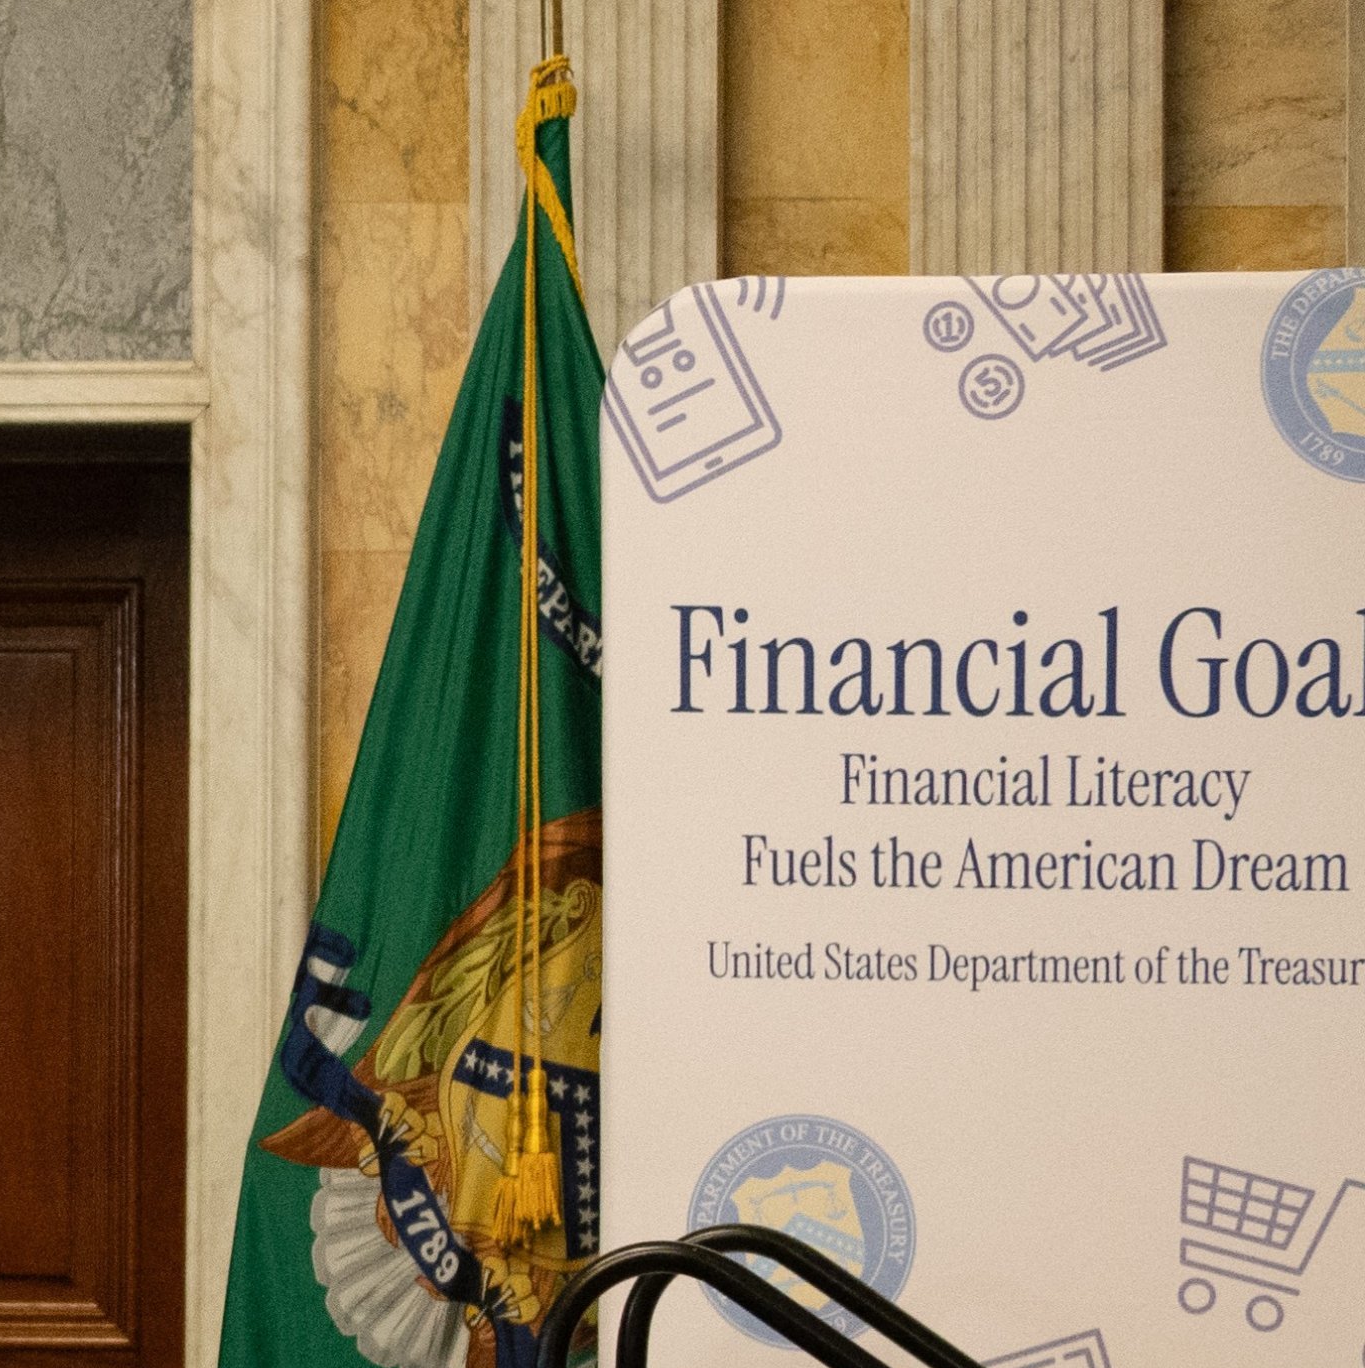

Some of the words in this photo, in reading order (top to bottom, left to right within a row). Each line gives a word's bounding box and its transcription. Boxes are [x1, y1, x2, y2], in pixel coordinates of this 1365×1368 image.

[1300, 431, 1345, 467] 1789
[670, 605, 1129, 719] Financial
[841, 753, 1053, 808] Financial
[1067, 755, 1253, 822] Literacy
[743, 834, 859, 889] Fuels
[871, 837, 943, 890] the
[955, 838, 1180, 892] American
[1193, 839, 1351, 893] Dream
[709, 941, 816, 980] United
[825, 943, 919, 982] States
[929, 944, 1126, 993] Department
[1134, 946, 1171, 986] of
[1177, 947, 1231, 986] the
[1238, 947, 1365, 987] Treasur
[696, 1127, 775, 1226] PARTMENT
[780, 1123, 810, 1142] OF
[816, 1126, 861, 1151] THE
[859, 1150, 908, 1265] TREASURY
[391, 1189, 460, 1284] 1789
